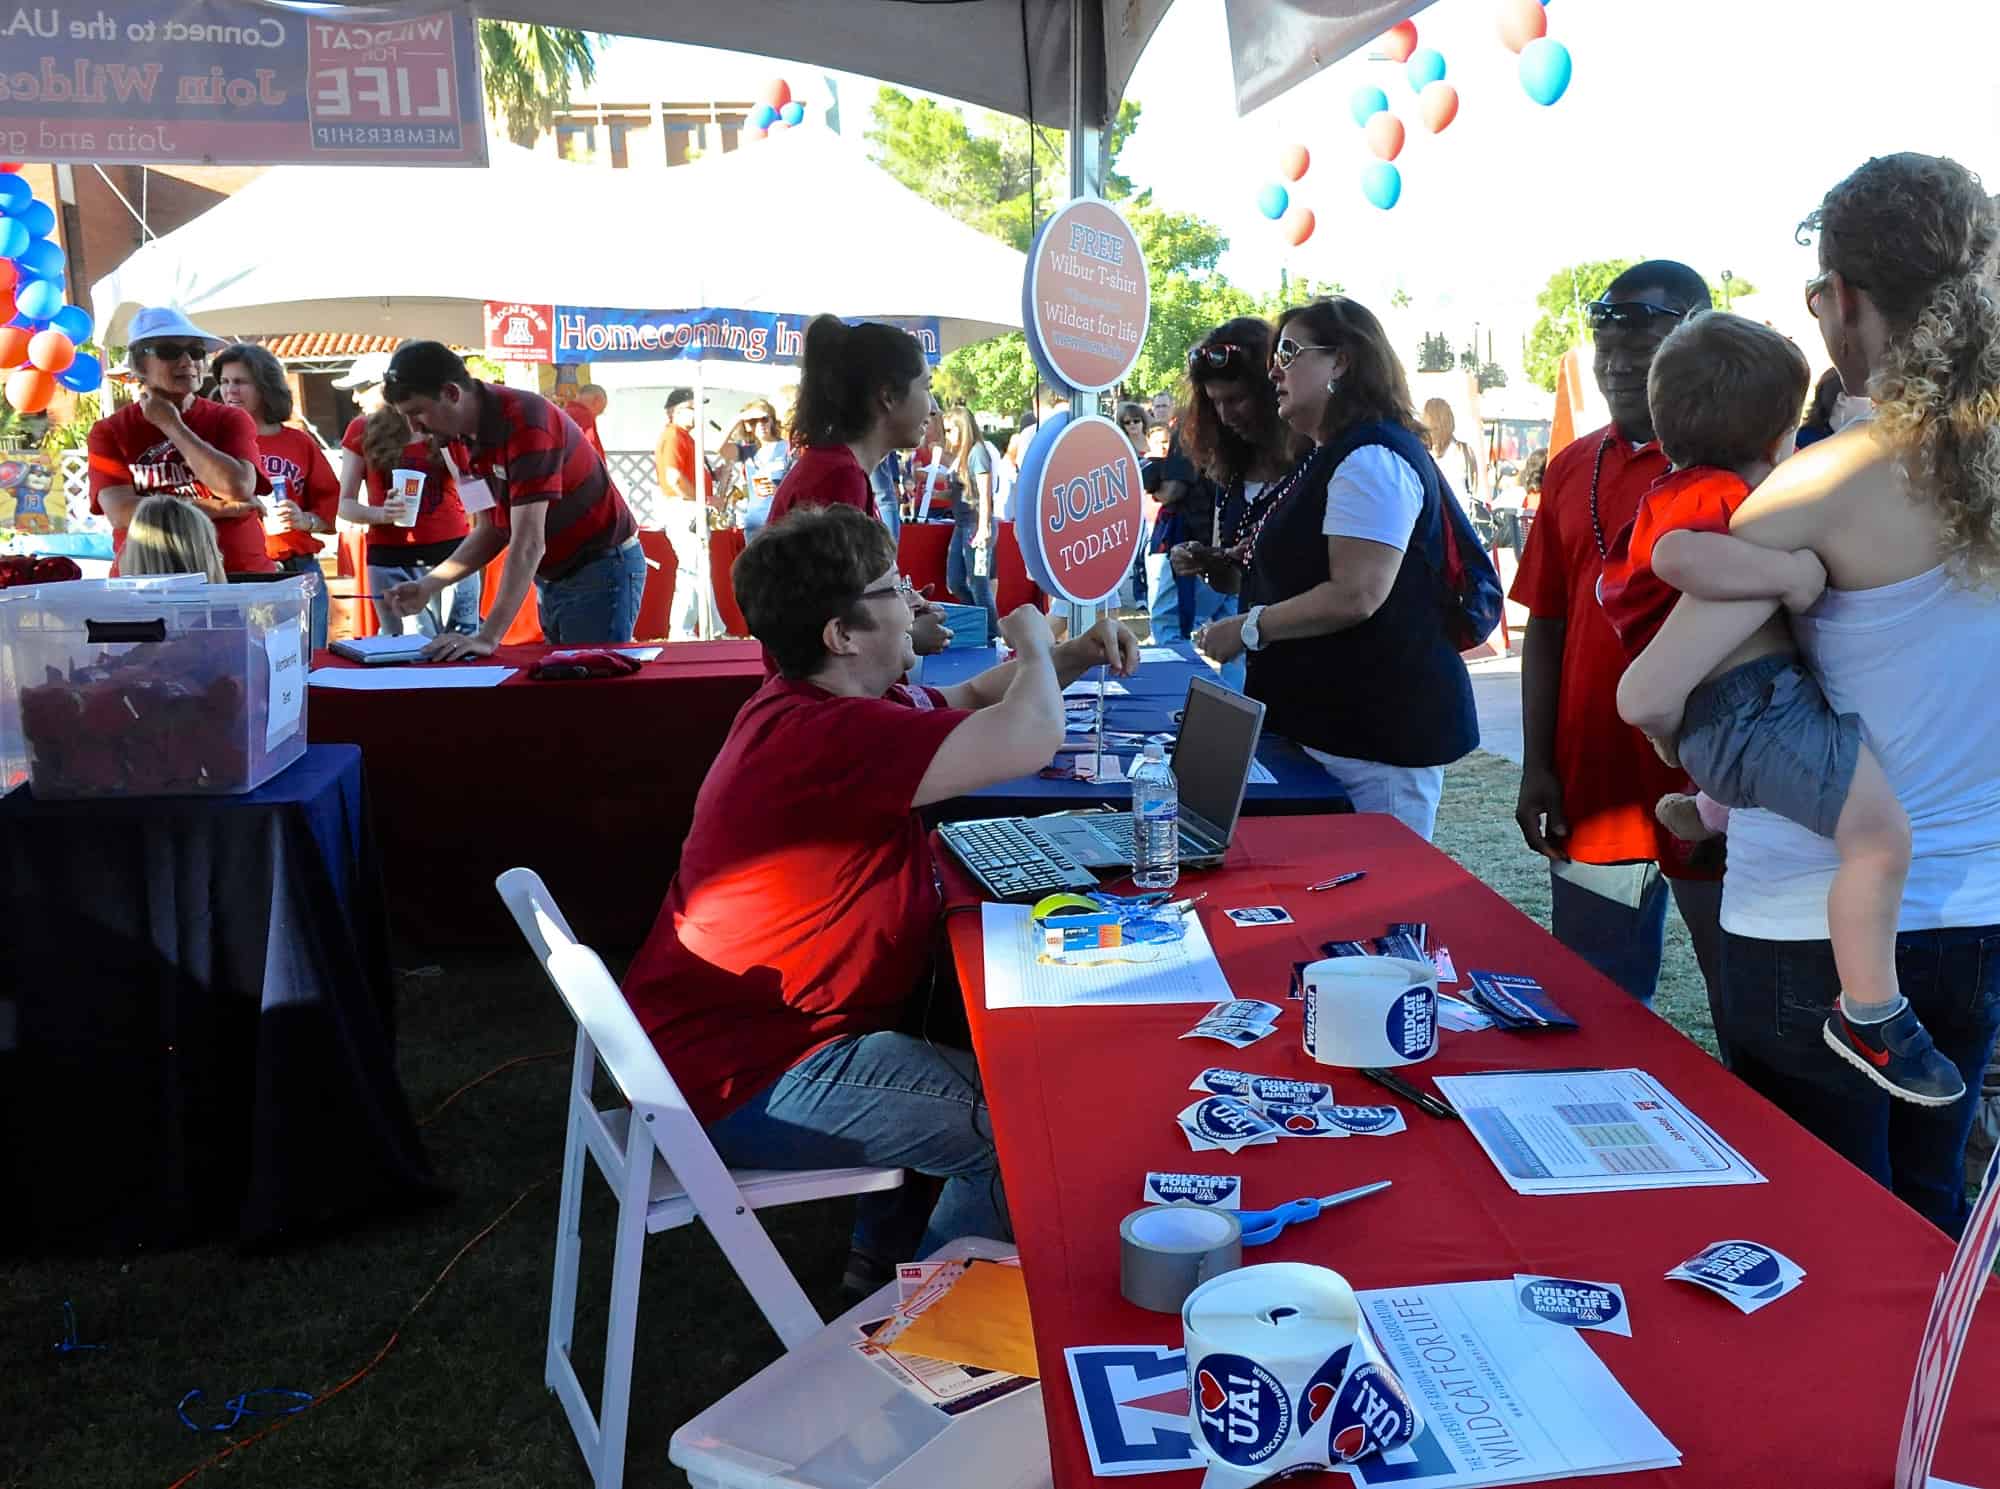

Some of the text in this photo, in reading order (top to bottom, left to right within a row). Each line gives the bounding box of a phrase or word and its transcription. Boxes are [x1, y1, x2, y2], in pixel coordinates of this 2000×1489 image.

[1070, 221, 1124, 266] FREE
[1050, 251, 1137, 295] Wilbur T-shirt
[560, 314, 767, 360] Homecoming
[1044, 301, 1138, 343] Wildcat for life
[1049, 458, 1129, 533] JOIN
[1060, 519, 1129, 572] TODAY!
[1306, 987, 1316, 1046] WILDCAT
[1404, 995, 1416, 1055] WILDCAT
[1416, 992, 1426, 1051] FOR LIFE
[1262, 1084, 1286, 1093] FOR
[1211, 1104, 1256, 1132] UA!
[1160, 1178, 1192, 1187] FOR
[1719, 1250, 1770, 1281] WILDCAT
[1720, 1245, 1752, 1261] FOR
[1530, 1286, 1609, 1299] WILDCAT
[1533, 1295, 1611, 1309] FOR LIFE
[1536, 1305, 1580, 1314] MEMBER
[1392, 1297, 1438, 1332] LIFE
[1416, 1334, 1465, 1374] FOR
[1201, 1409, 1224, 1432] I
[1228, 1374, 1260, 1444] UA!
[1352, 1380, 1401, 1447] UA!
[1441, 1379, 1525, 1467] WILDCAT
[1248, 1433, 1283, 1461] WILDCAT
[1279, 1416, 1289, 1433] FOR
